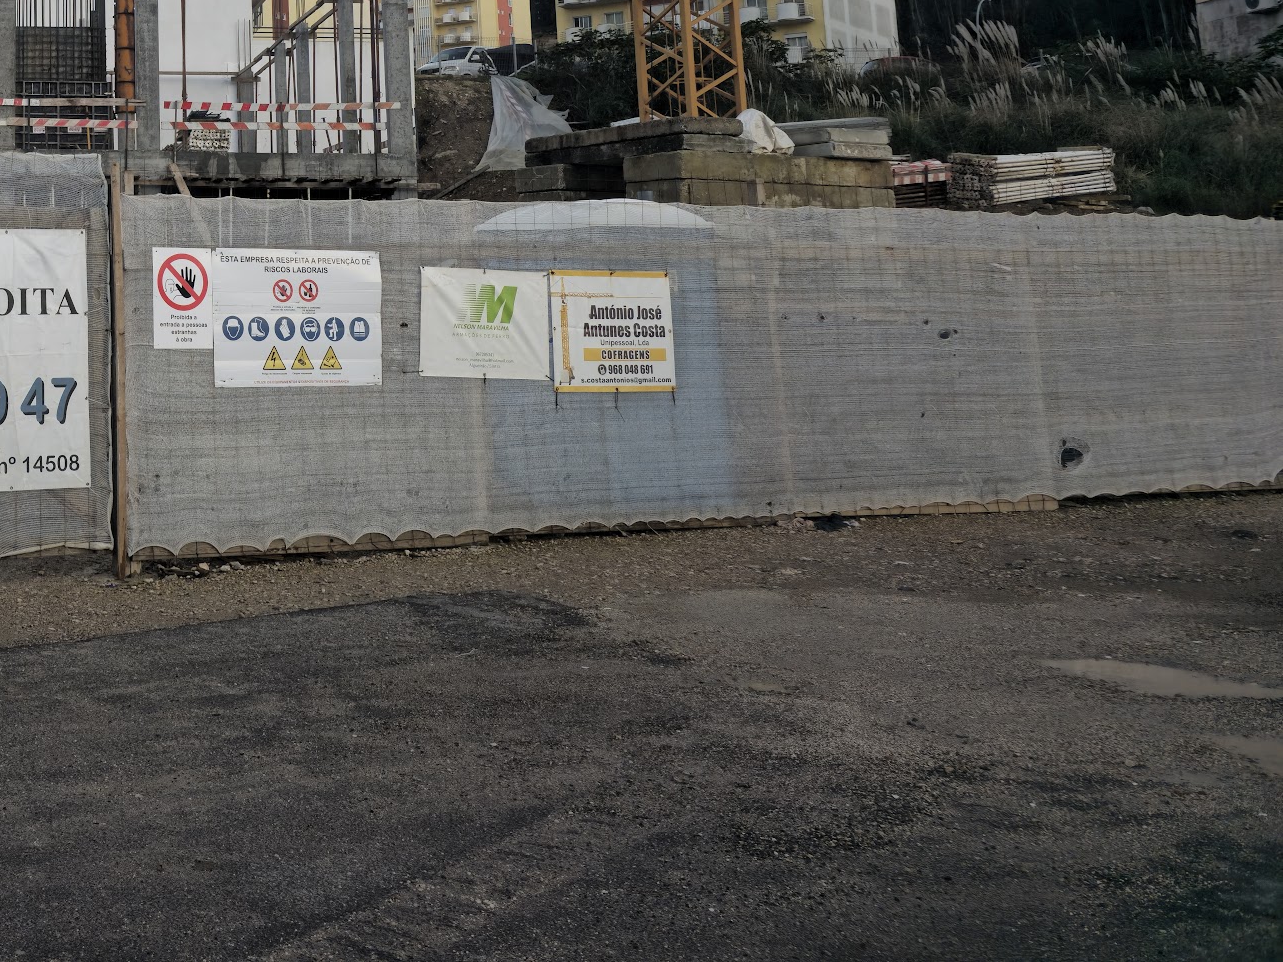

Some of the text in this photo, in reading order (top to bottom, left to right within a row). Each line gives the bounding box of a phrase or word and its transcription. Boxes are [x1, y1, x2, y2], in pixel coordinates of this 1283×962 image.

[220, 255, 371, 267] ESTA EMPRESA RESPEITA A PREVENÇÃO DE
[264, 265, 328, 275] RISCOS LABORAIS
[589, 304, 662, 320] António José
[583, 322, 666, 338] Antunes Costa
[600, 339, 637, 347] Unipessoal,
[601, 350, 650, 360] COFRAGENS
[608, 364, 654, 375] 968 048 691
[19, 376, 78, 425] 47
[22, 454, 80, 473] 14508
